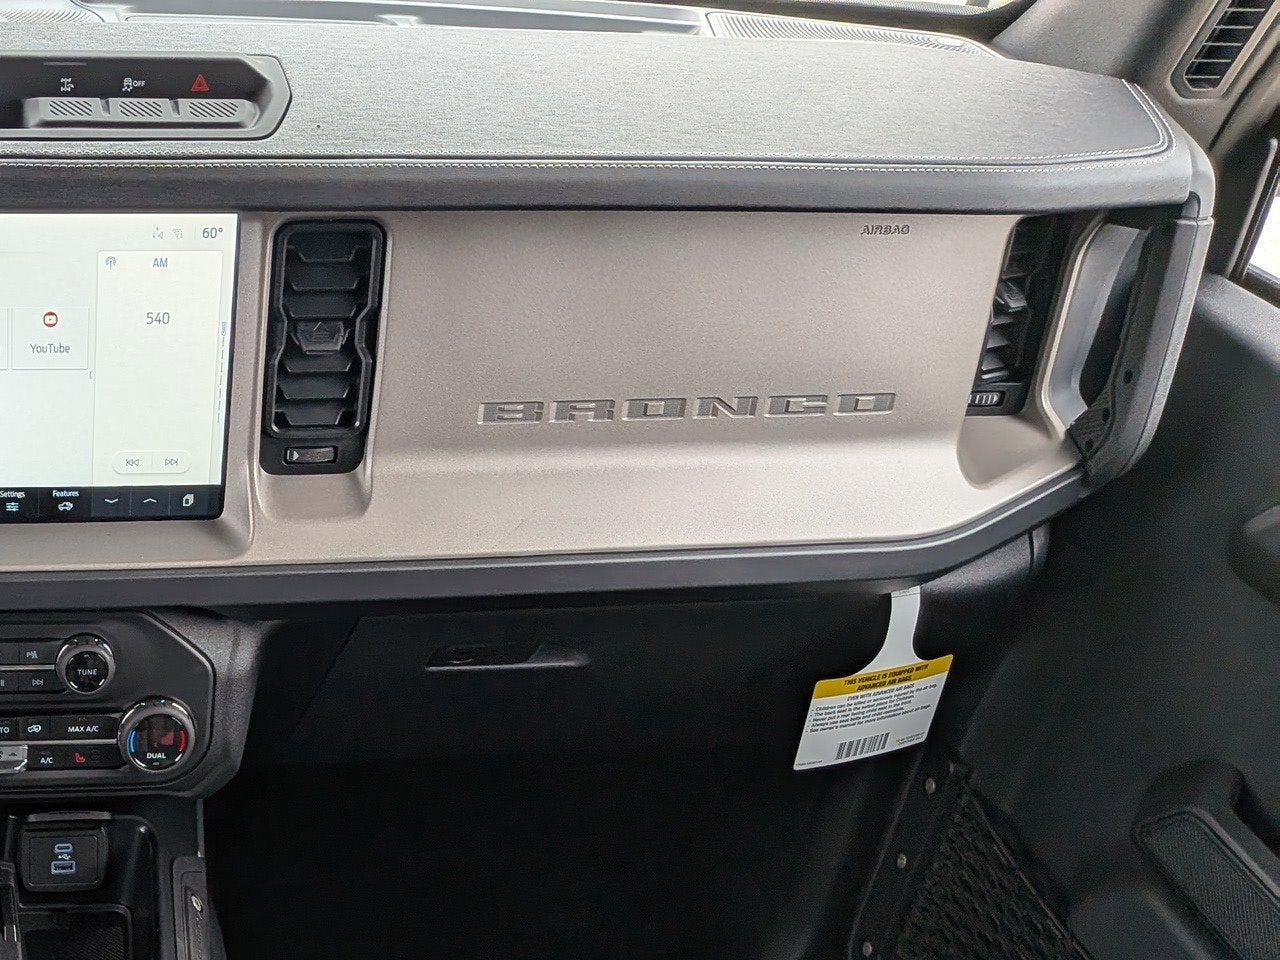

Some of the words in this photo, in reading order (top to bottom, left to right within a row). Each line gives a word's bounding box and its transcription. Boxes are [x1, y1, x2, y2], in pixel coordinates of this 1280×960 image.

[202, 227, 223, 239] 60°
[860, 224, 910, 236] AIRBAG
[152, 257, 168, 268] AM
[146, 312, 170, 325] 540
[30, 343, 71, 354] YouTube
[477, 392, 897, 425] BRONCO
[0, 490, 26, 499] Settings
[52, 490, 80, 498] Features
[77, 668, 98, 676] TUNE
[858, 675, 881, 683] VEHICLE
[889, 668, 914, 677] EQUIPPED
